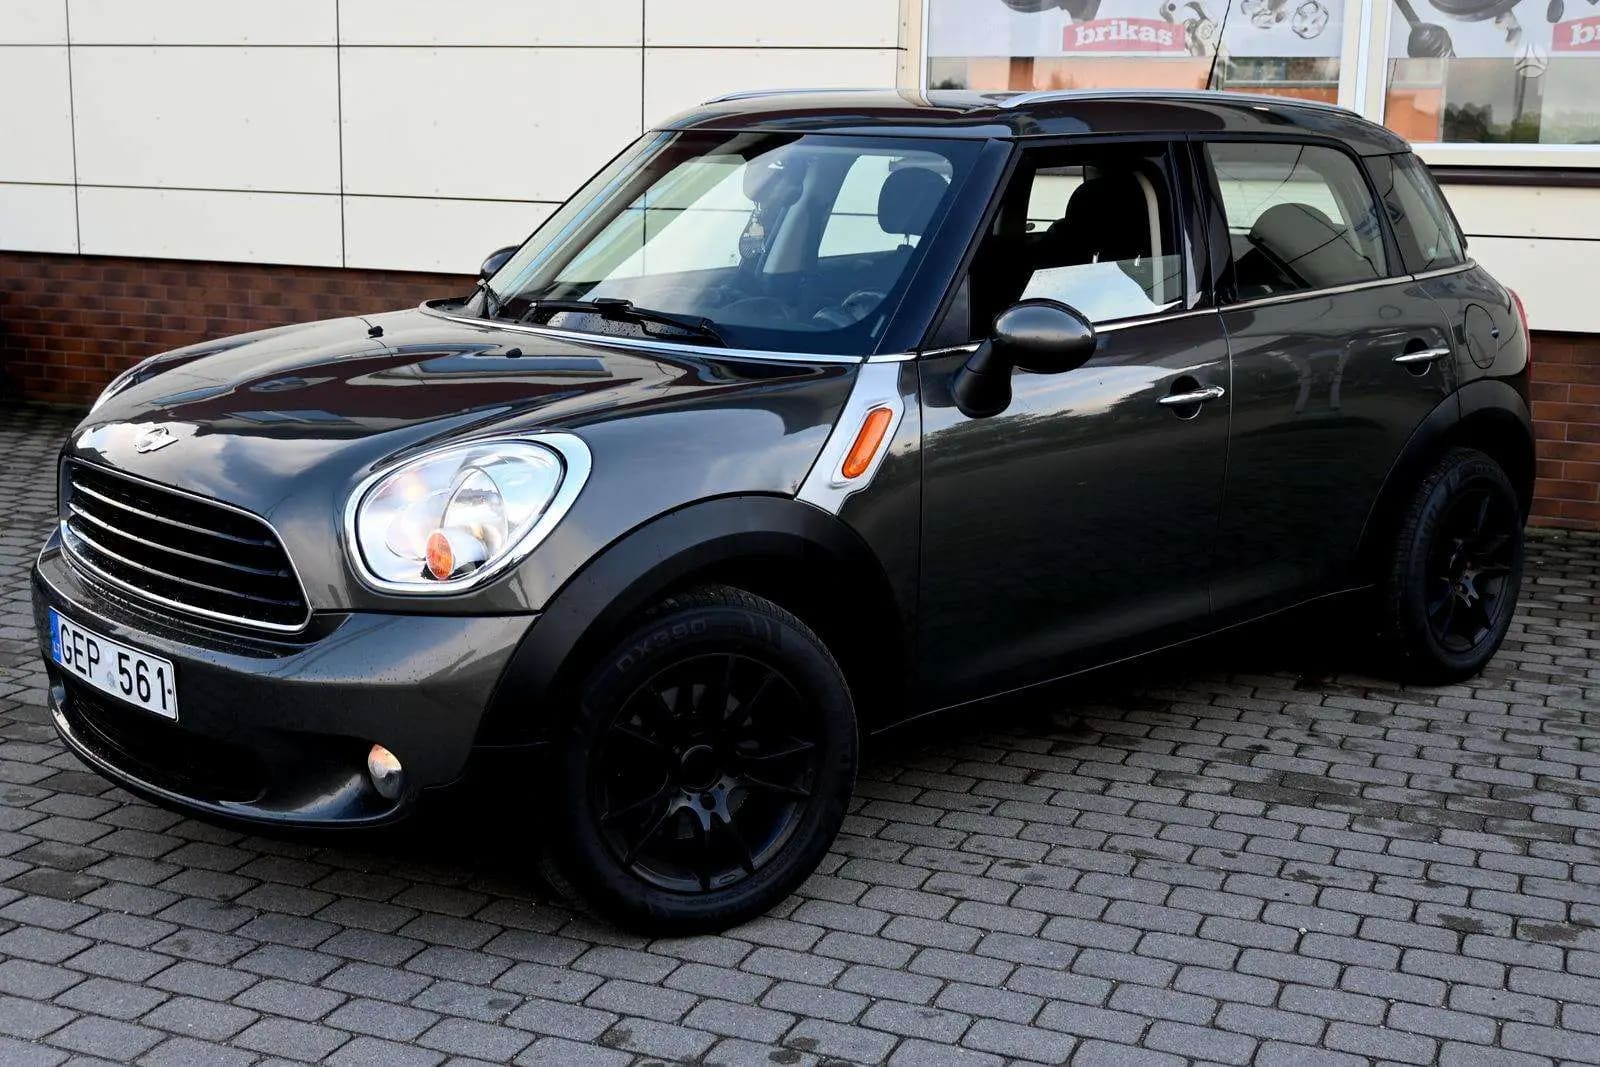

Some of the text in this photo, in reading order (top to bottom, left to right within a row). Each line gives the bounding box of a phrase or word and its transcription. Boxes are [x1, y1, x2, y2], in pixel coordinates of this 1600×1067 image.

[1075, 19, 1174, 46] brikas
[60, 623, 167, 710] GEP 561
